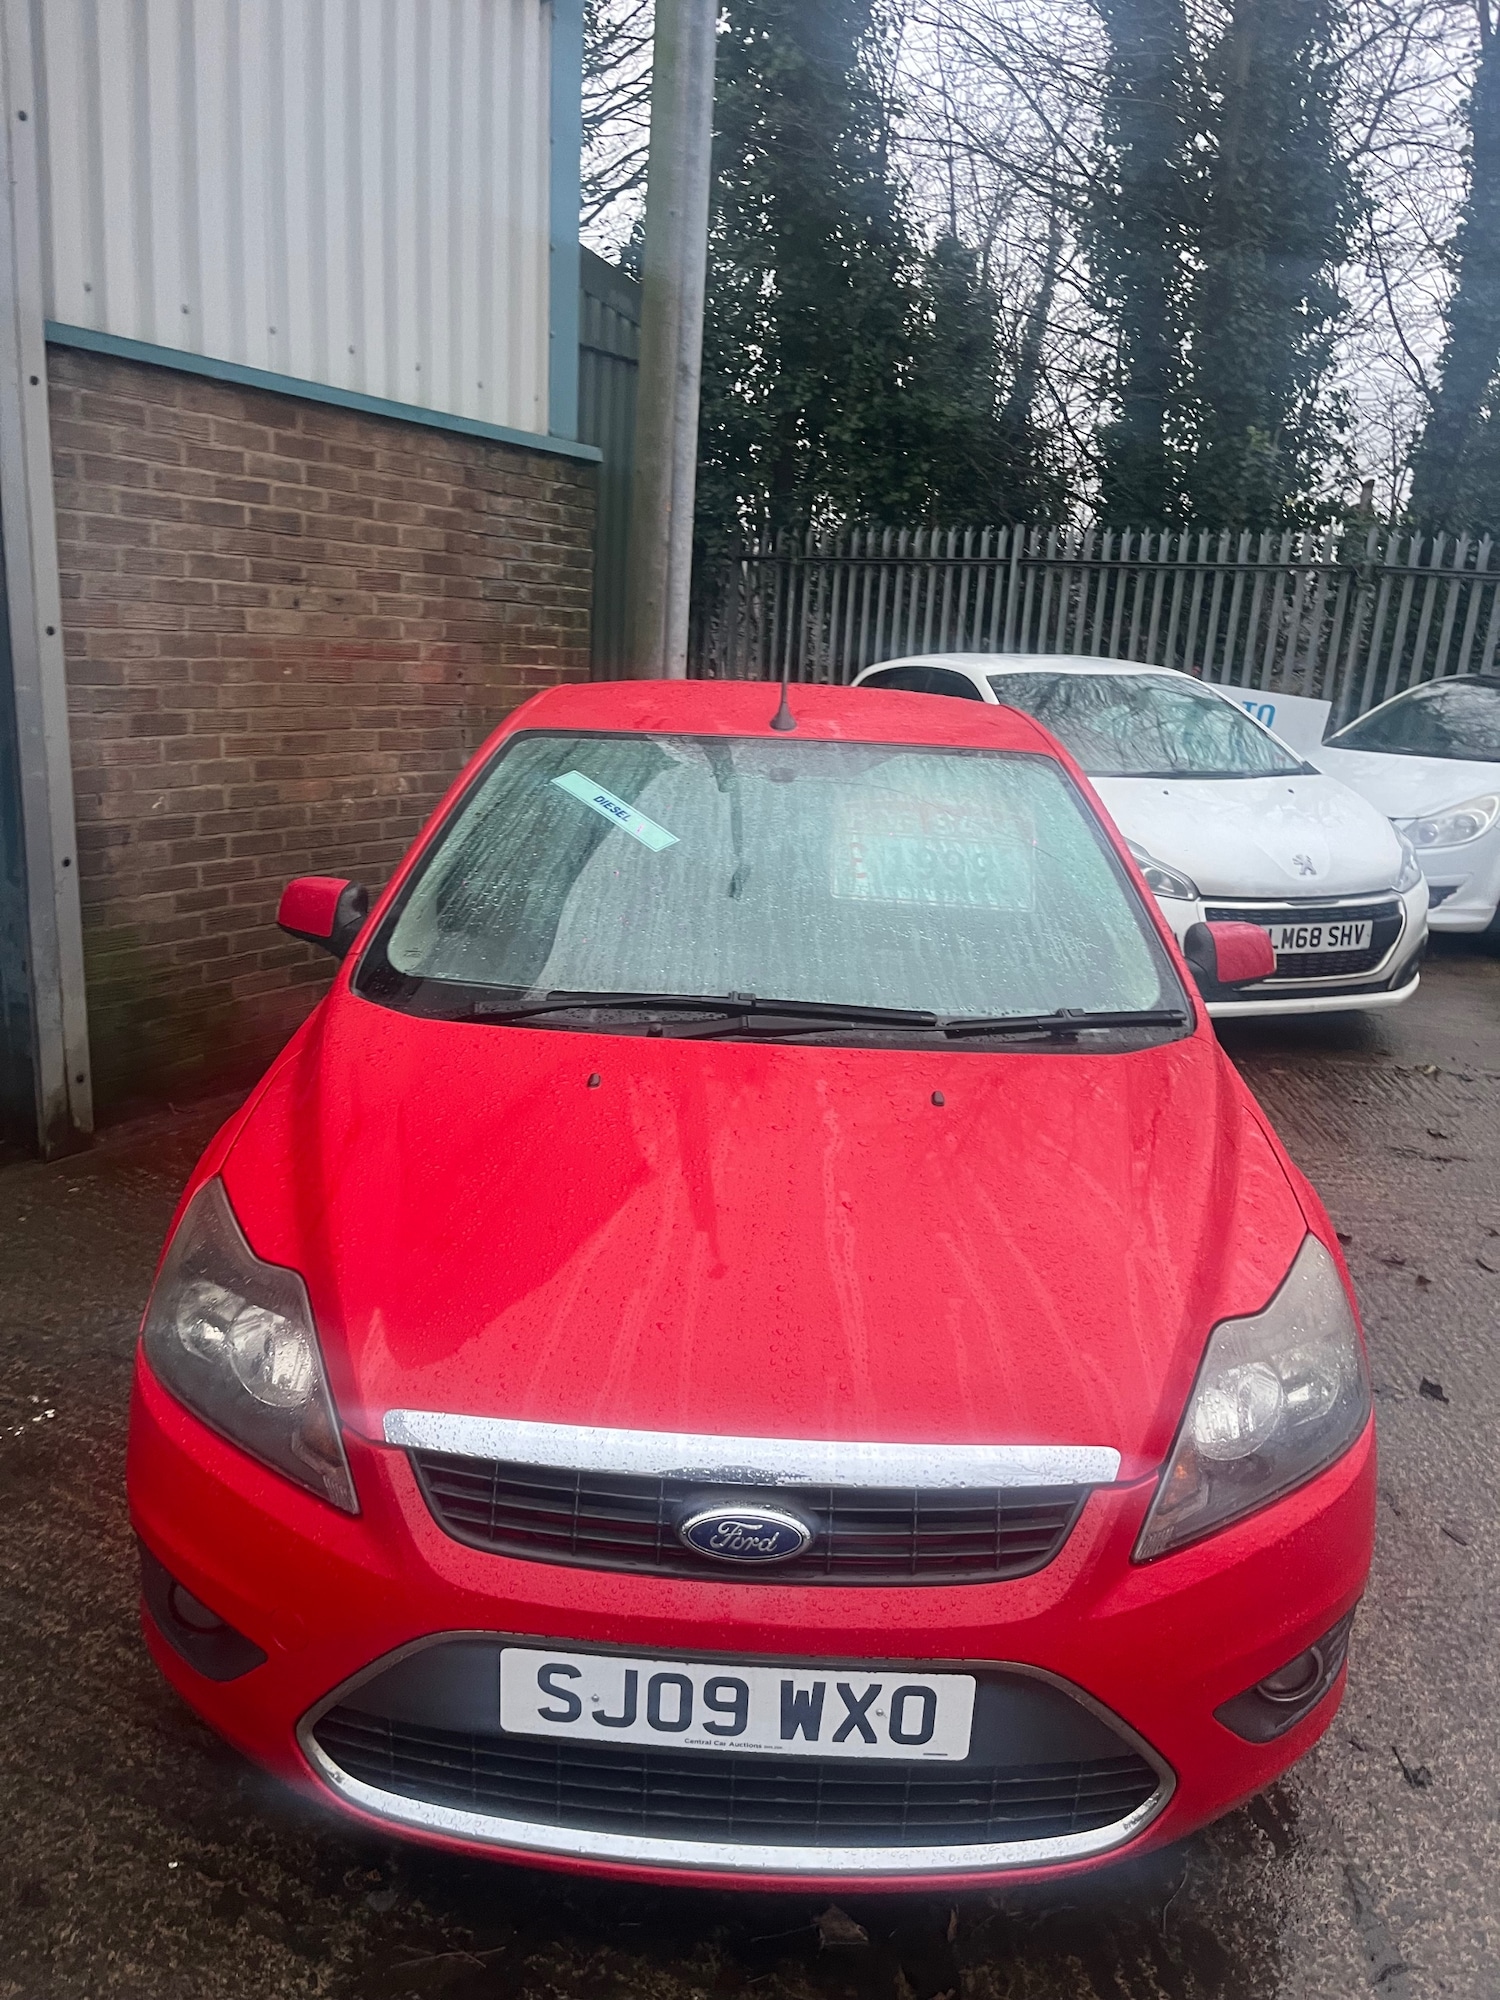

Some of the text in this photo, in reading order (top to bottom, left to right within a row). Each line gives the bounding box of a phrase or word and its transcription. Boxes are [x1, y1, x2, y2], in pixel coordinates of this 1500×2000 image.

[593, 795, 632, 822] DIESEL
[1328, 924, 1365, 947] SHV
[710, 1521, 780, 1552] Ford
[537, 1662, 937, 1746] SJ09 WXO
[684, 1738, 712, 1746] Central
[729, 1741, 762, 1749] Auctions
